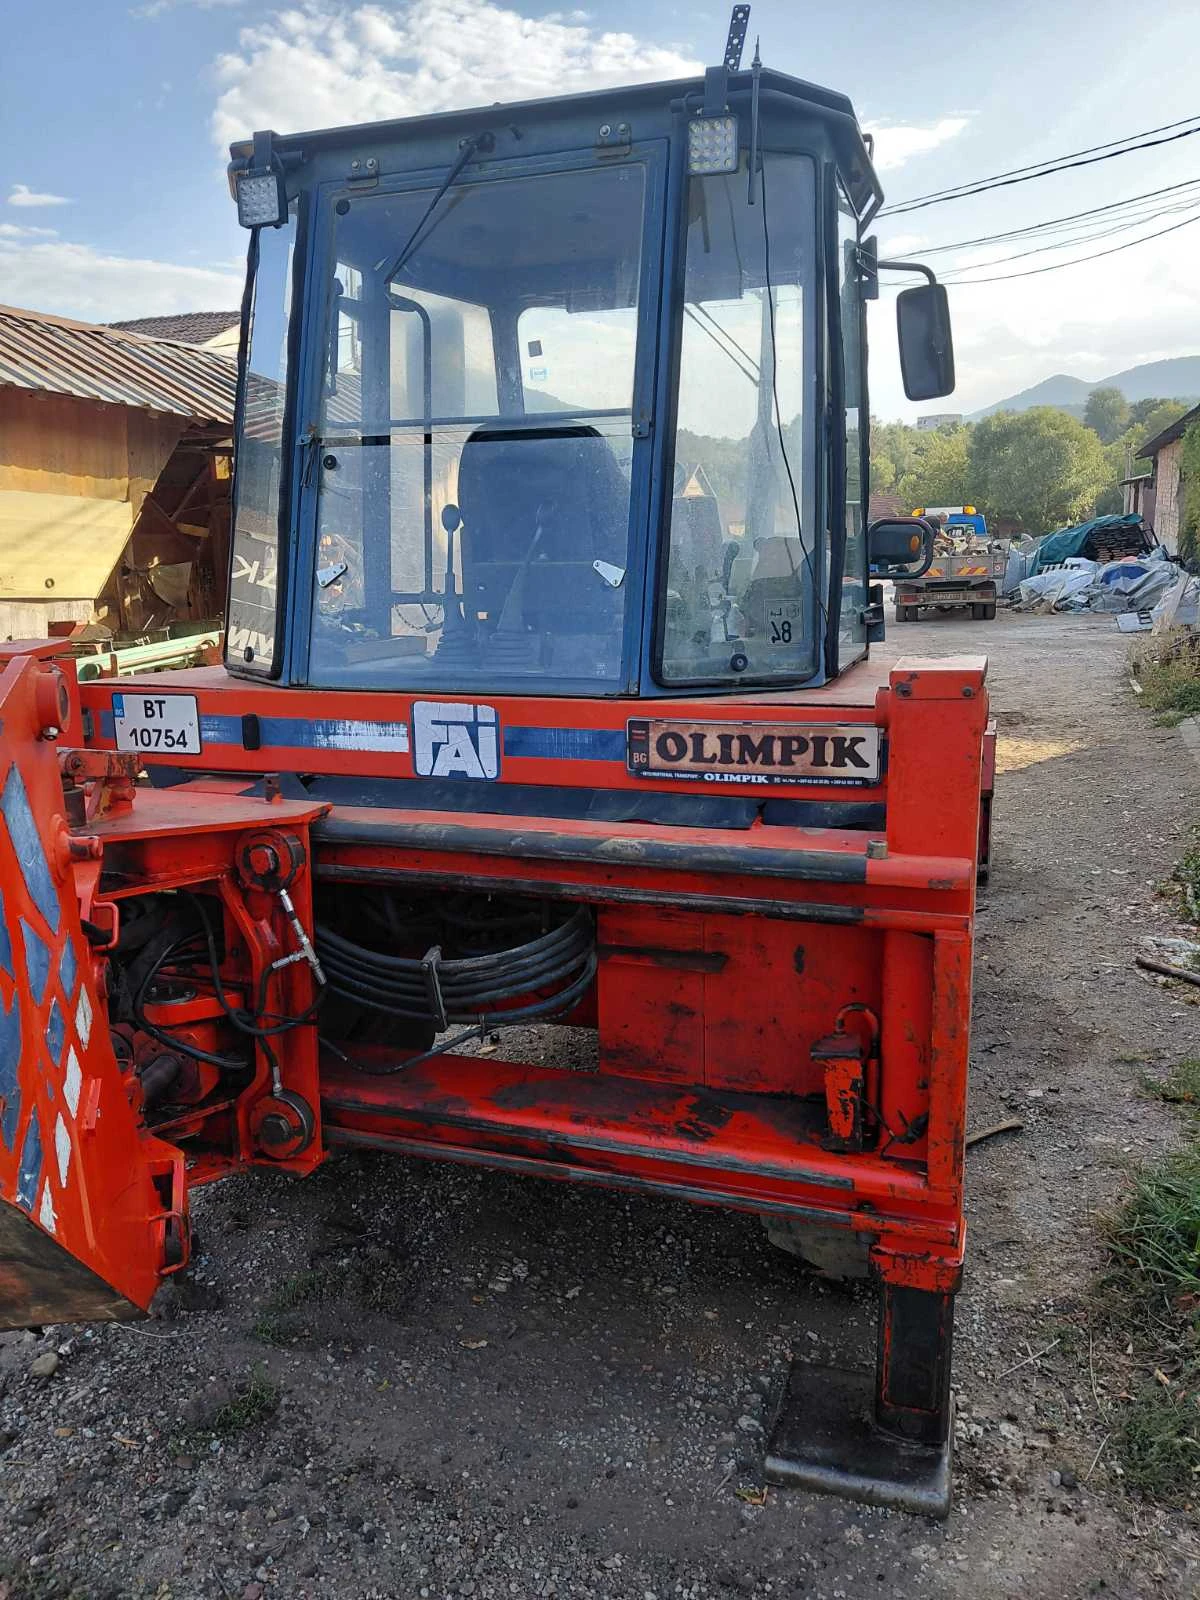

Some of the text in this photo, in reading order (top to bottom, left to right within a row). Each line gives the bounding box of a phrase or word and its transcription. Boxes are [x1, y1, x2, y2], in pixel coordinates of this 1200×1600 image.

[143, 700, 166, 718] BT
[129, 728, 188, 748] 10754
[633, 752, 647, 764] BG
[655, 731, 870, 769] OLIMPIK
[703, 772, 769, 784] OLIMPIK
